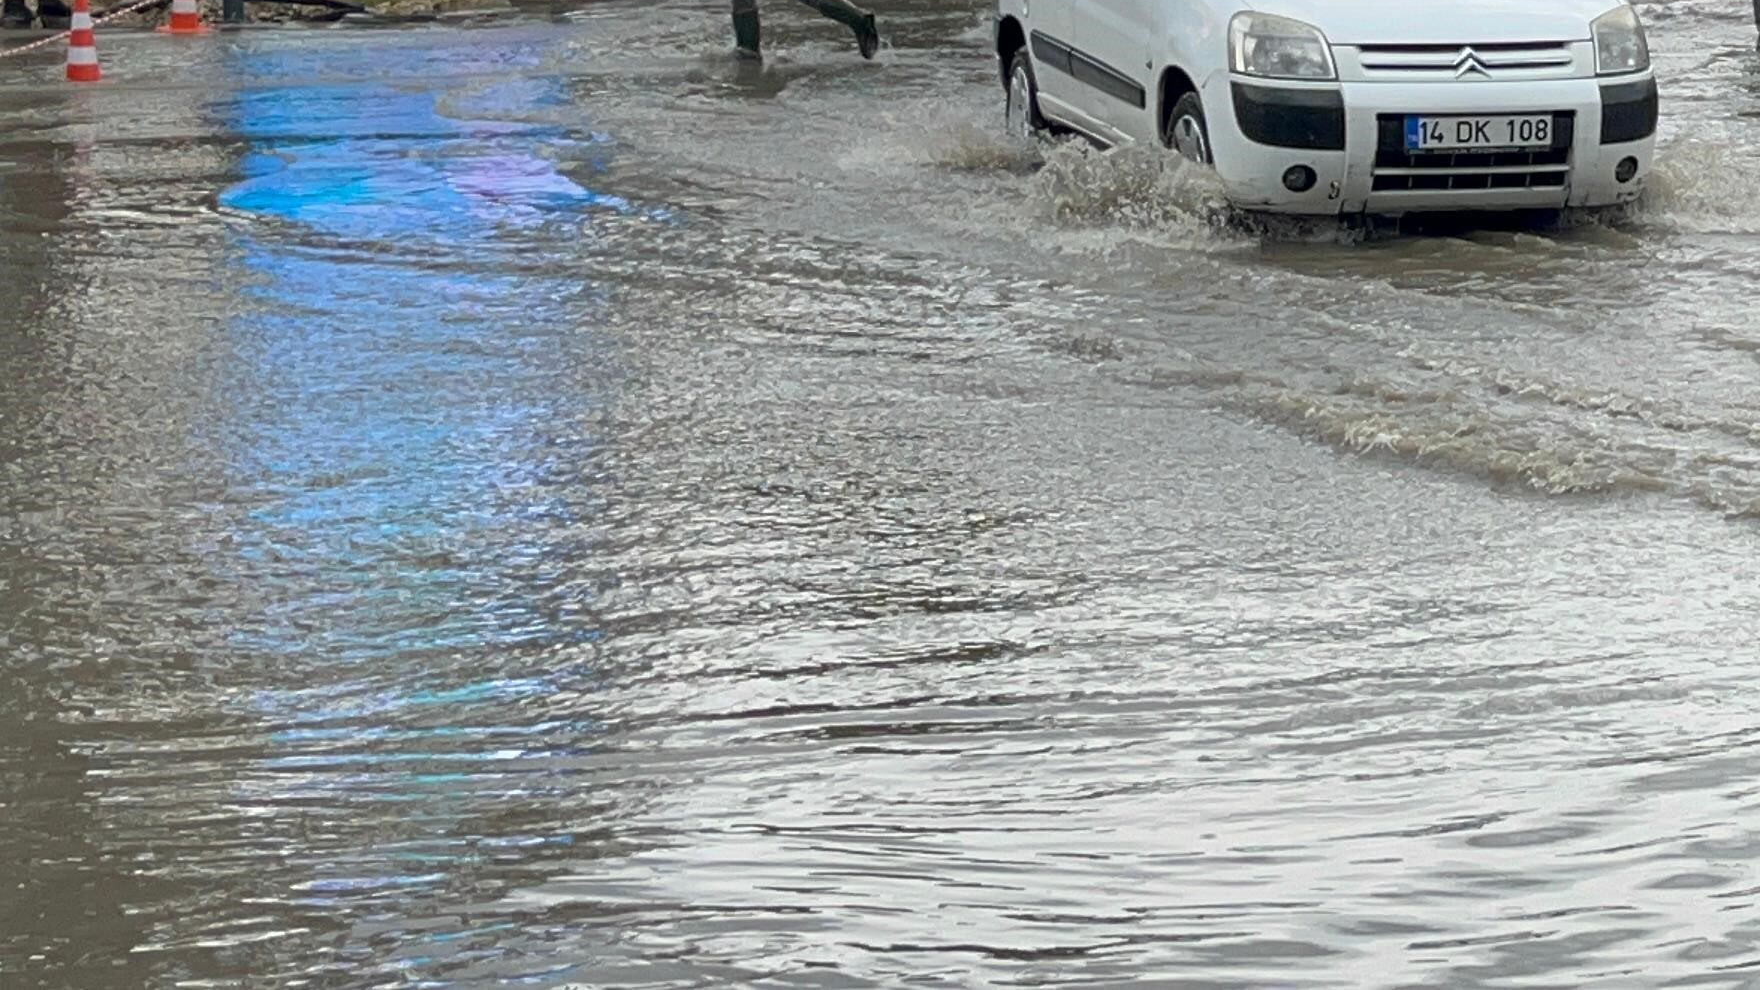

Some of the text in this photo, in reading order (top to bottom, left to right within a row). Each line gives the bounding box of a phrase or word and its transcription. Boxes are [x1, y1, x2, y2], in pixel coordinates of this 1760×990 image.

[1420, 118, 1548, 145] 14 DK 108
